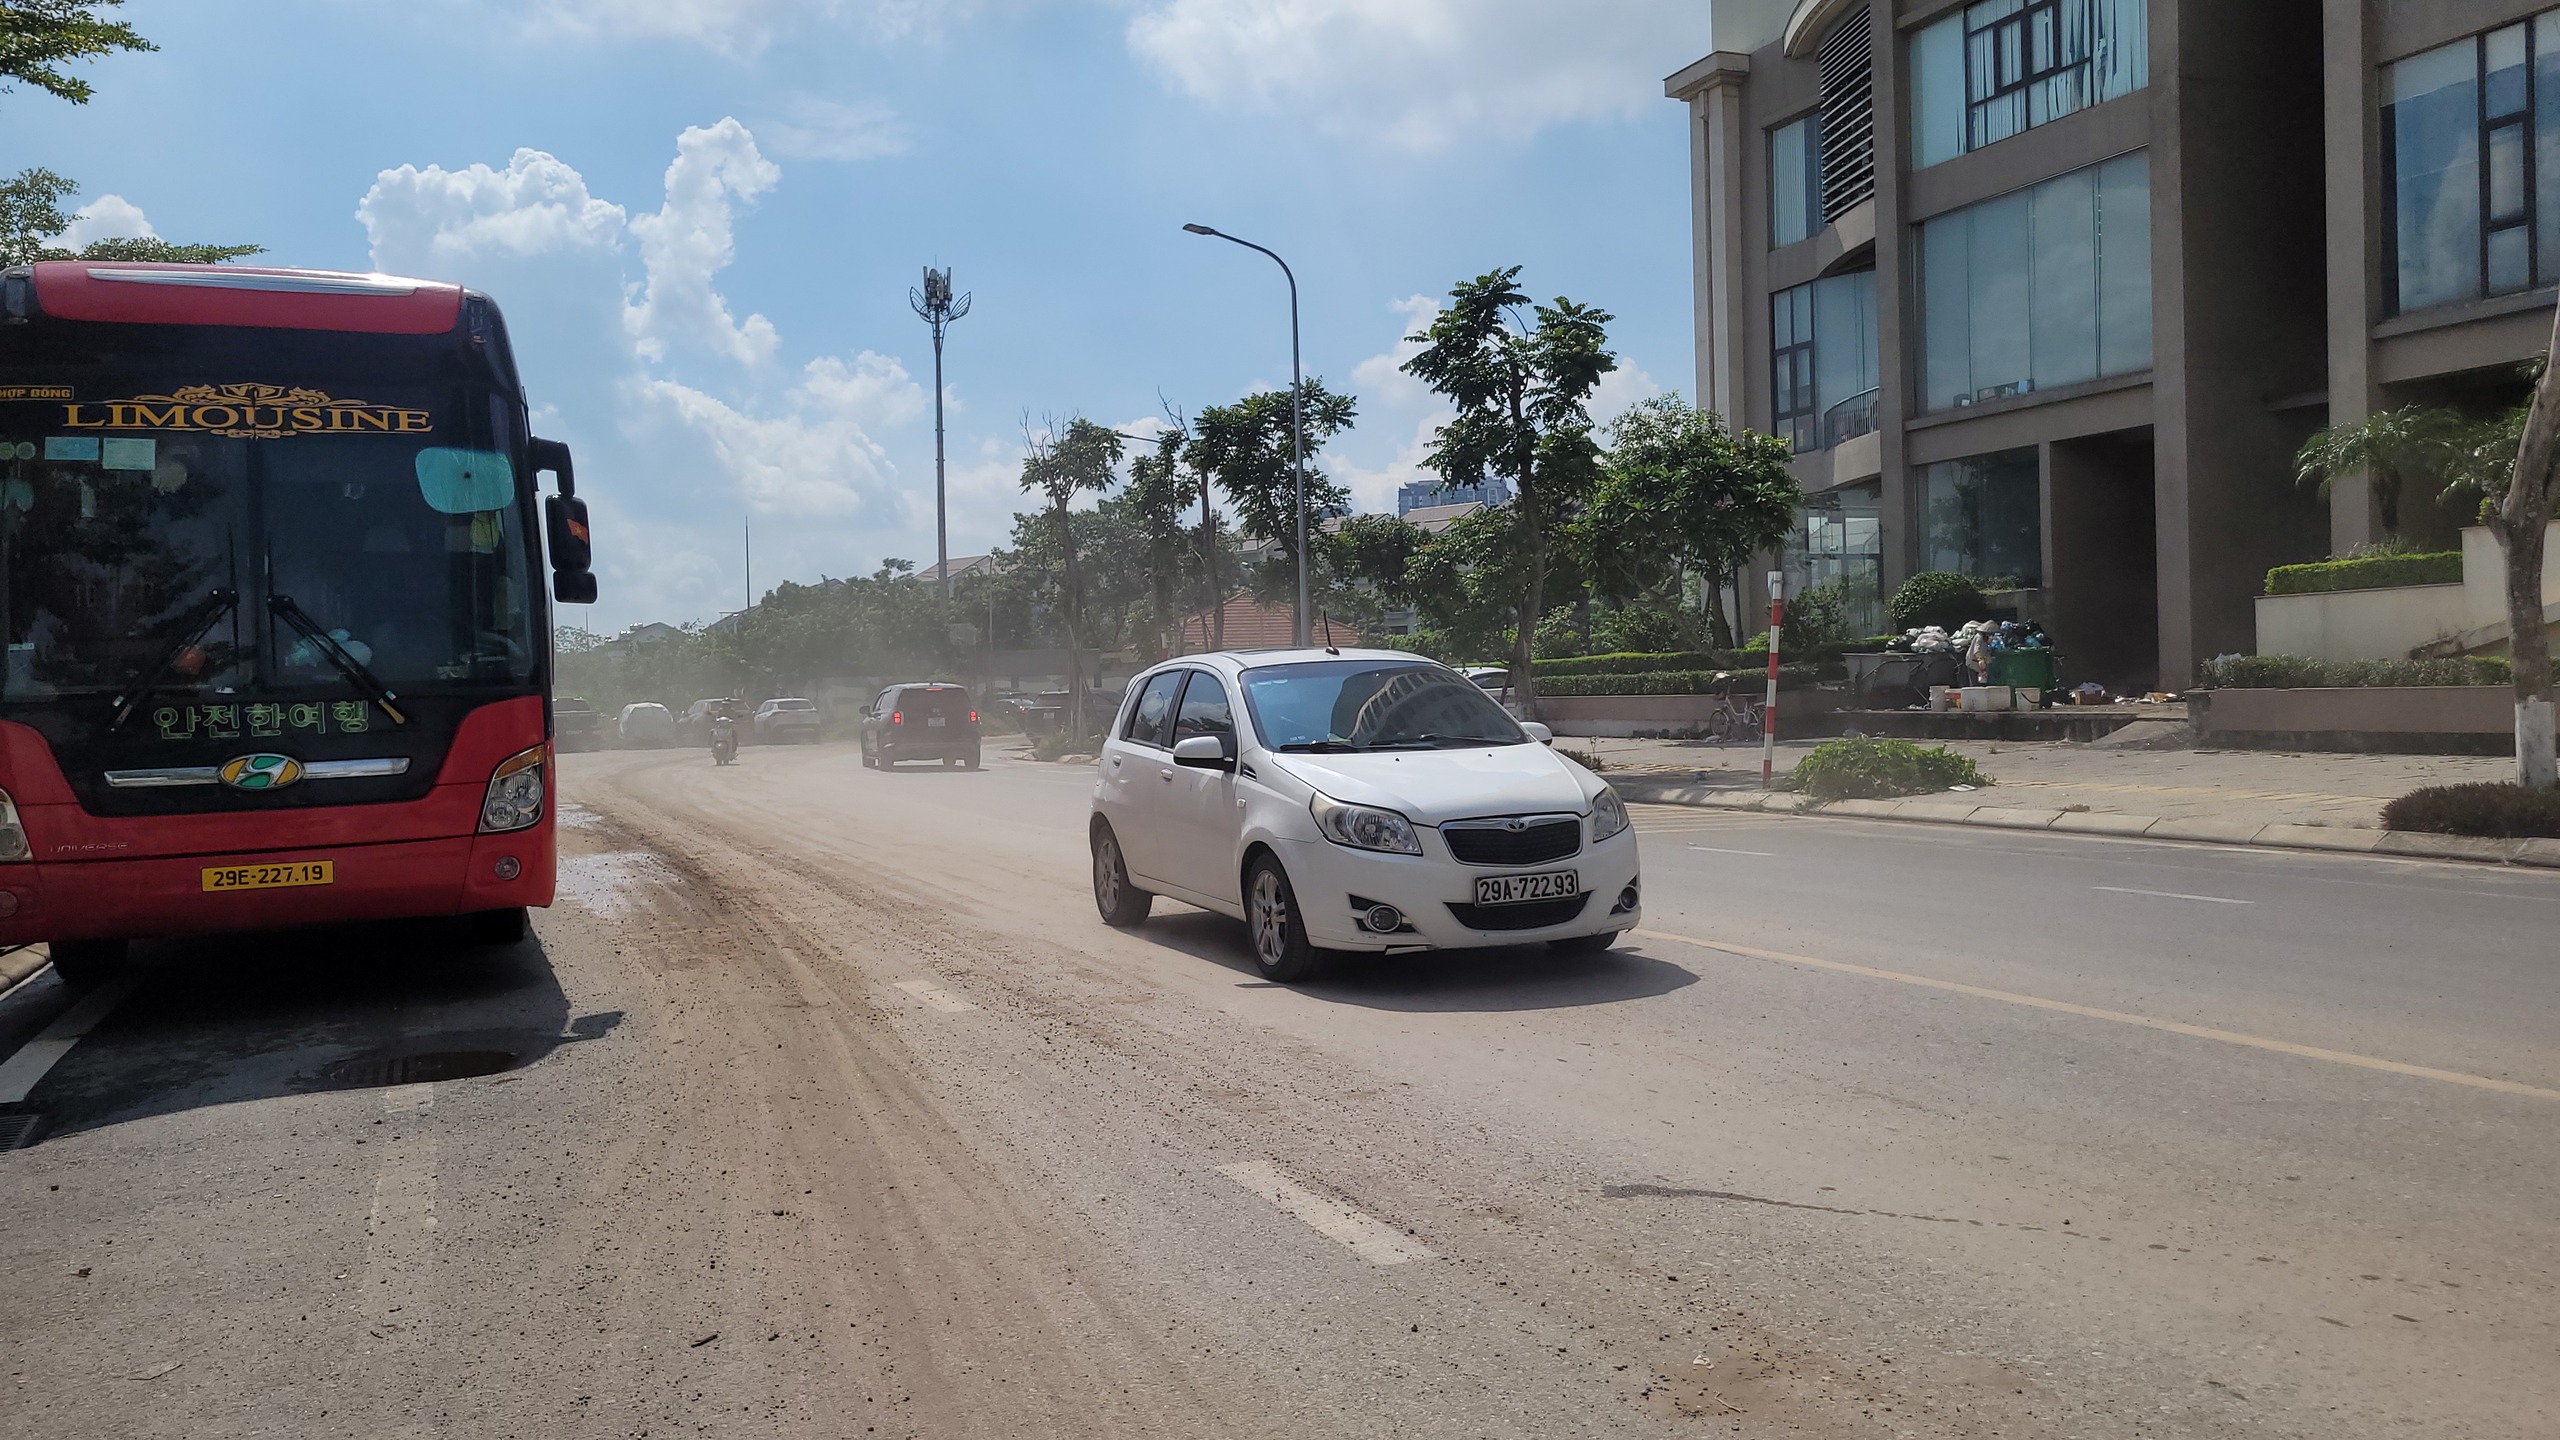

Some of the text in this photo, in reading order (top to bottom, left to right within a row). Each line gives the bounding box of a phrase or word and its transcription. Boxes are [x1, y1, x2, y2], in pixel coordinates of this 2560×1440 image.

[62, 404, 433, 432] LIMOUSINE
[153, 700, 369, 739] 안전한여행
[49, 842, 129, 853] UNIVERSE
[213, 865, 323, 887] 29E-227.19
[1479, 874, 1576, 903] 29A-722.93
